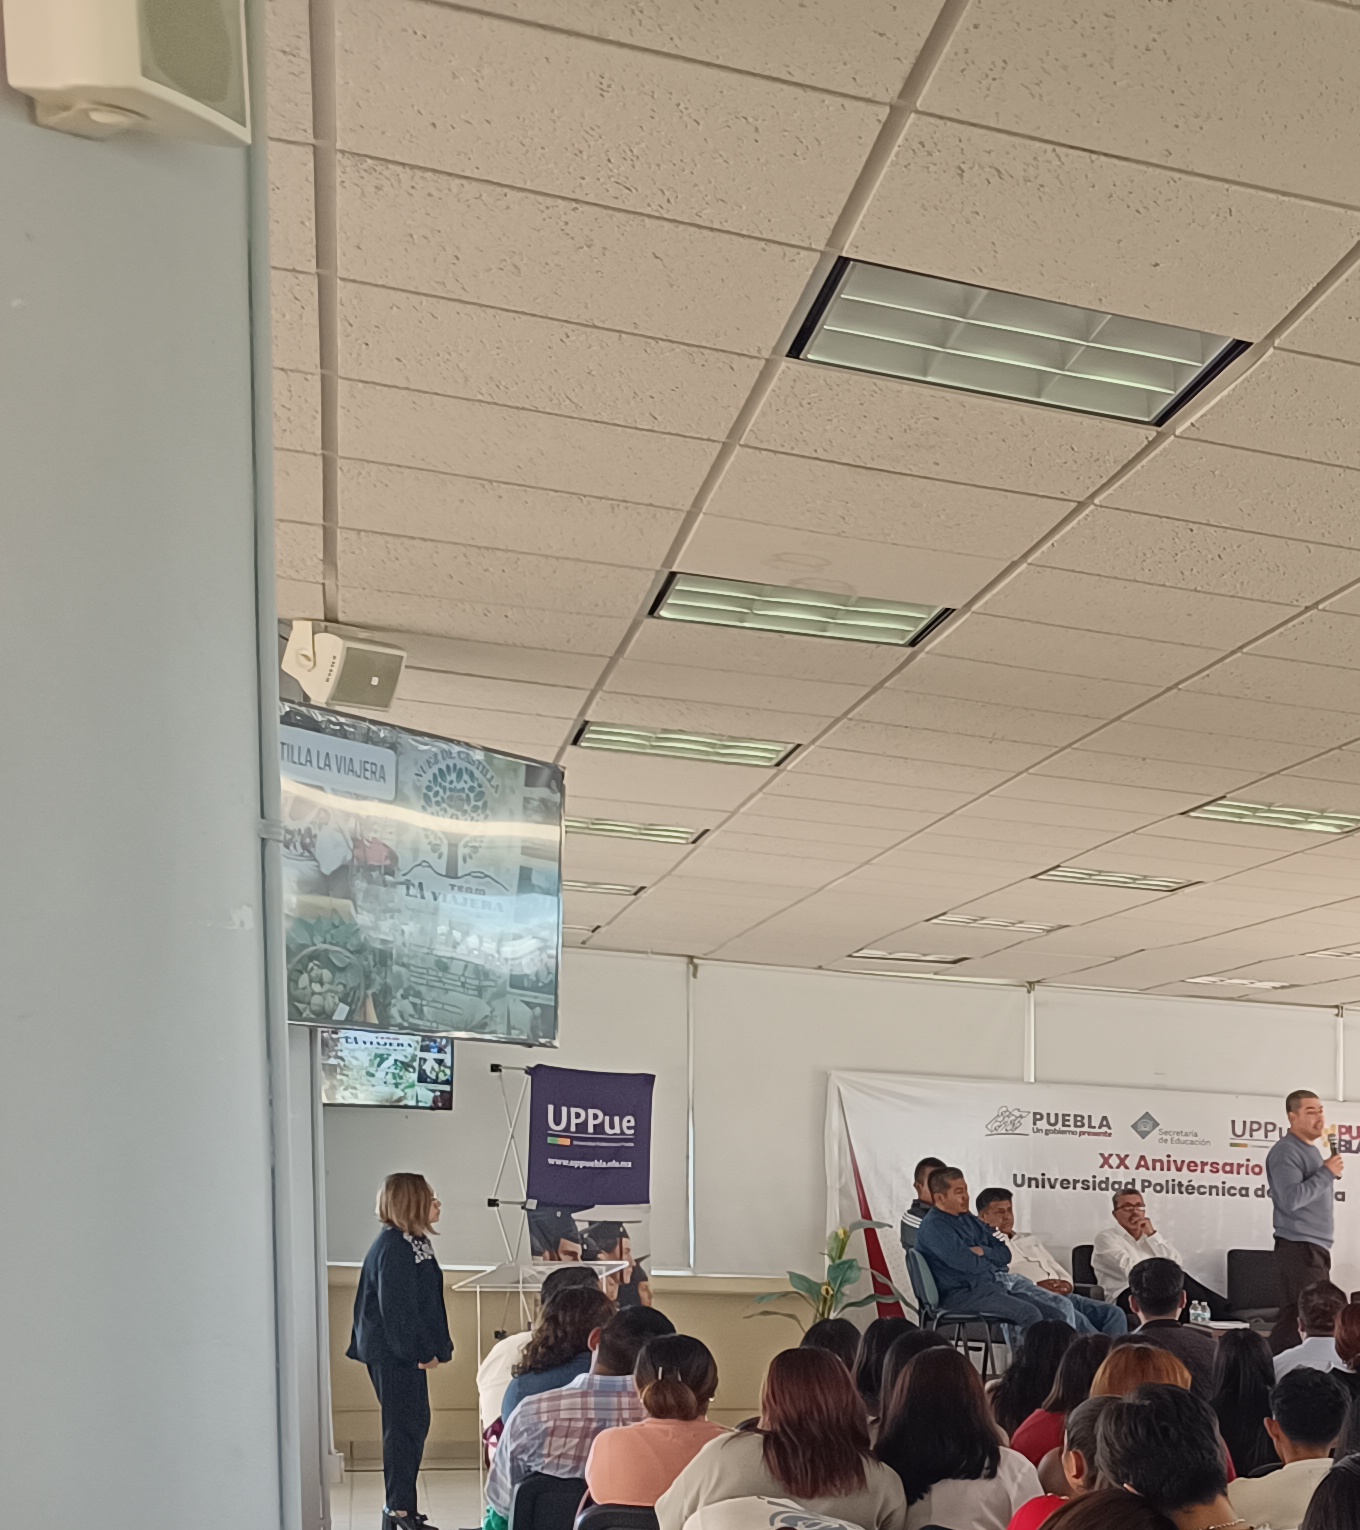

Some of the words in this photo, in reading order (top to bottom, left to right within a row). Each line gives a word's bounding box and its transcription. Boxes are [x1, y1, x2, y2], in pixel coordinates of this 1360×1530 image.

[316, 749, 332, 771] LA
[335, 753, 387, 784] VIAJERA
[547, 1104, 635, 1135] UPPue
[1032, 1111, 1112, 1130] PUEBLA
[1230, 1119, 1291, 1139] UPPu
[1158, 1128, 1198, 1137] Secretaría
[1170, 1137, 1211, 1146] Educación
[1099, 1153, 1130, 1170] XX
[1135, 1154, 1263, 1176] Aniversario
[1012, 1173, 1136, 1192] Universidad
[1140, 1178, 1250, 1198] Politécnica
